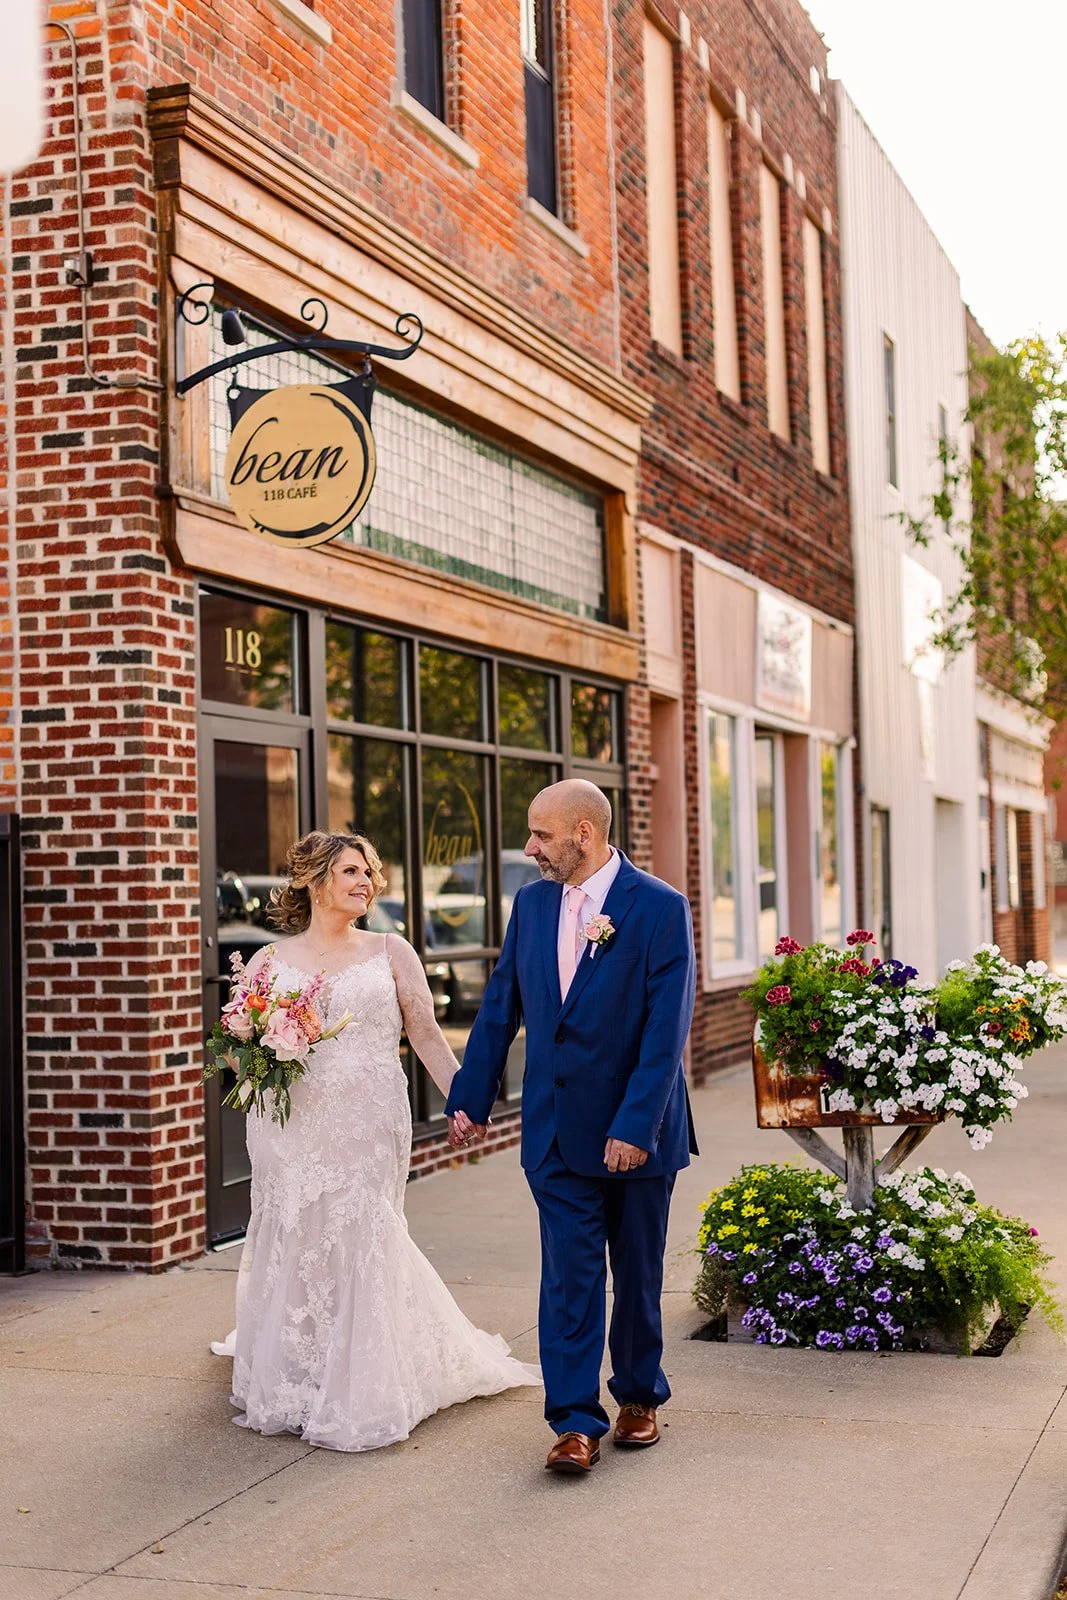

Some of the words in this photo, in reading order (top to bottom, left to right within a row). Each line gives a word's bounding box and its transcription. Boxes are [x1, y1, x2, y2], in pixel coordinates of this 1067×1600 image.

[230, 417, 348, 485] bean
[264, 489, 285, 501] 118
[287, 482, 318, 500] CAFÉ
[225, 627, 262, 668] 118
[425, 800, 474, 865] bean
